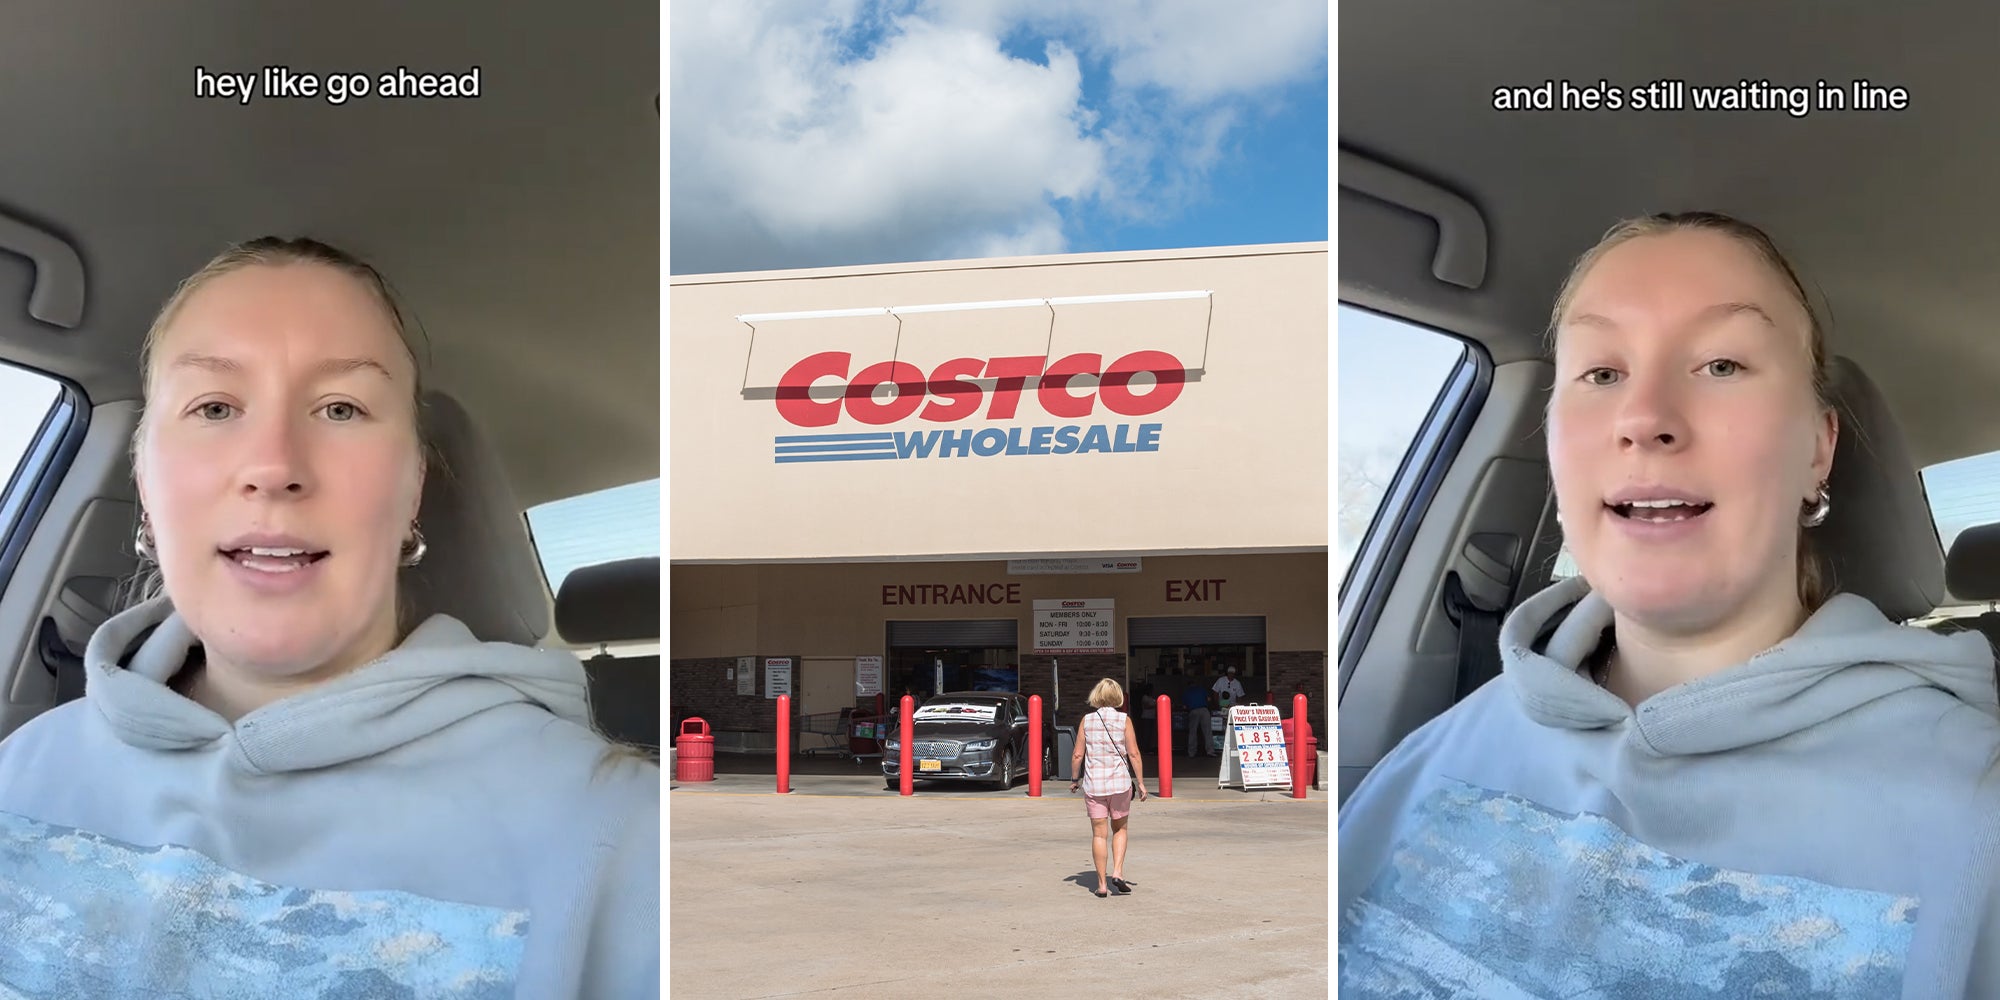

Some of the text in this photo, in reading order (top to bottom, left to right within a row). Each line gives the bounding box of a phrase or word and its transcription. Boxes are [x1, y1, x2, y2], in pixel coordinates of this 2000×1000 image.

[776, 350, 1185, 427] COSTCO
[892, 423, 1163, 459] WHOLESALE
[882, 583, 1021, 606] ENTRANCE
[1165, 579, 1227, 602] EXIT
